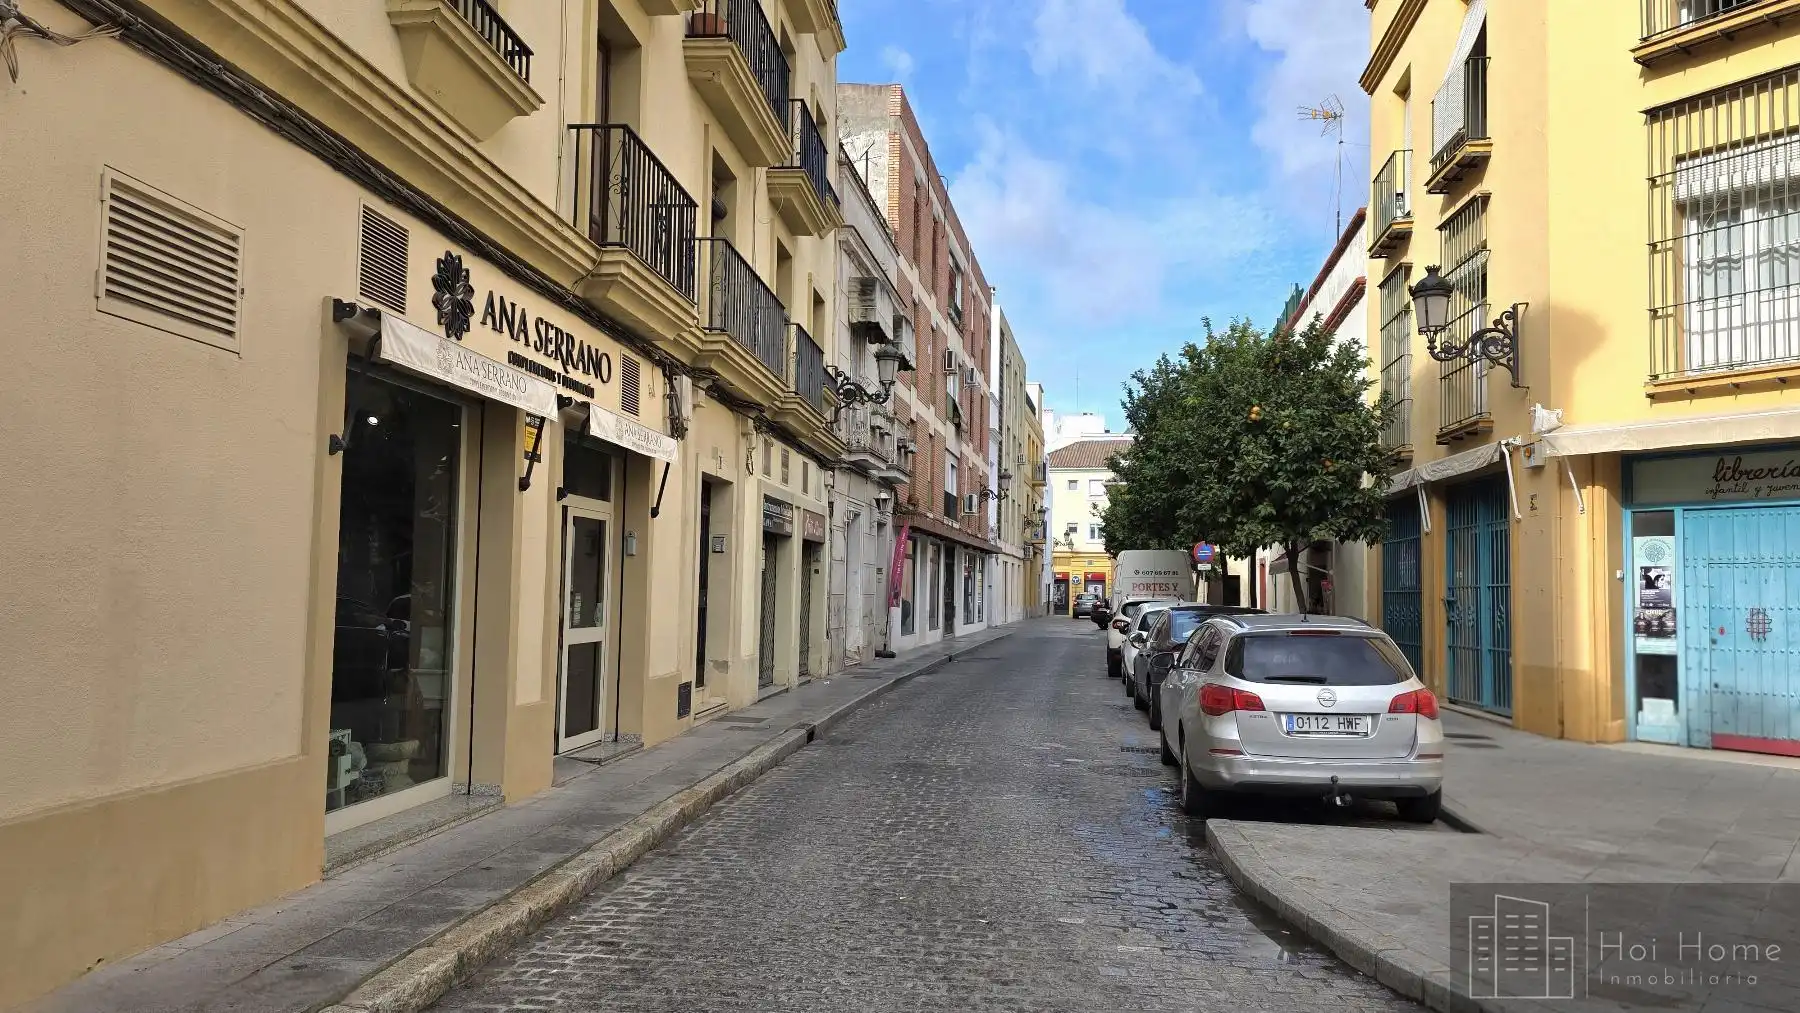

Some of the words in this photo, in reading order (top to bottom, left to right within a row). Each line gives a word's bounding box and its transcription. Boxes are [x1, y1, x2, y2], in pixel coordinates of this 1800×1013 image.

[480, 290, 530, 347] ANA
[533, 316, 612, 384] SERRANO
[456, 350, 480, 377] ANA
[481, 361, 528, 394] SERRANO
[1705, 482, 1748, 499] infantil
[1754, 486, 1762, 498] y
[1131, 582, 1170, 592] PORTES
[1171, 582, 1179, 591] Y
[1296, 716, 1330, 730] 0112
[1338, 717, 1362, 730] HWF
